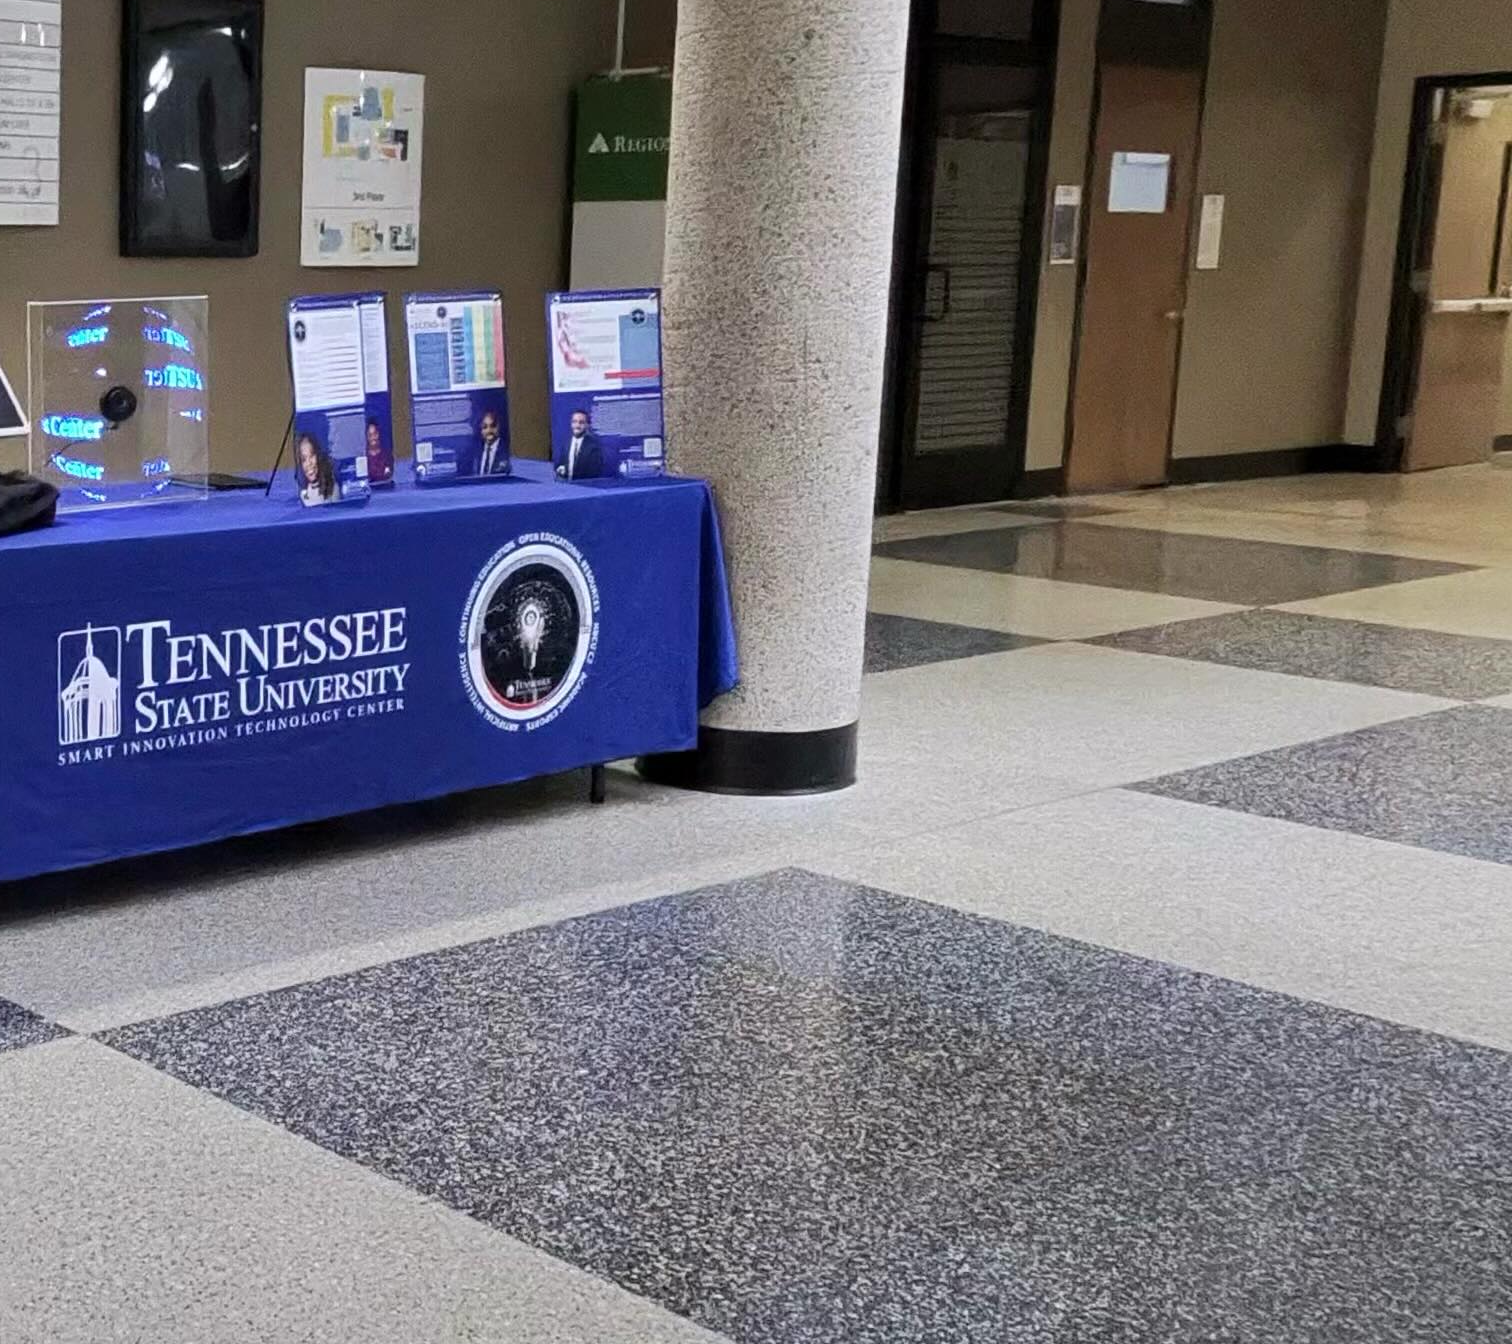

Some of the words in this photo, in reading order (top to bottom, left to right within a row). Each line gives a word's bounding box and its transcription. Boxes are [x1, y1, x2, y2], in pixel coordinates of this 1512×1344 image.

[126, 607, 407, 688] TENNESSEE
[57, 745, 115, 766] SMART
[123, 725, 228, 756] INNOVATION
[236, 709, 342, 737] TECHNOLOGY
[347, 698, 405, 718] CENTER
[135, 690, 230, 734] STATE
[237, 663, 411, 716] UNIVERSITY
